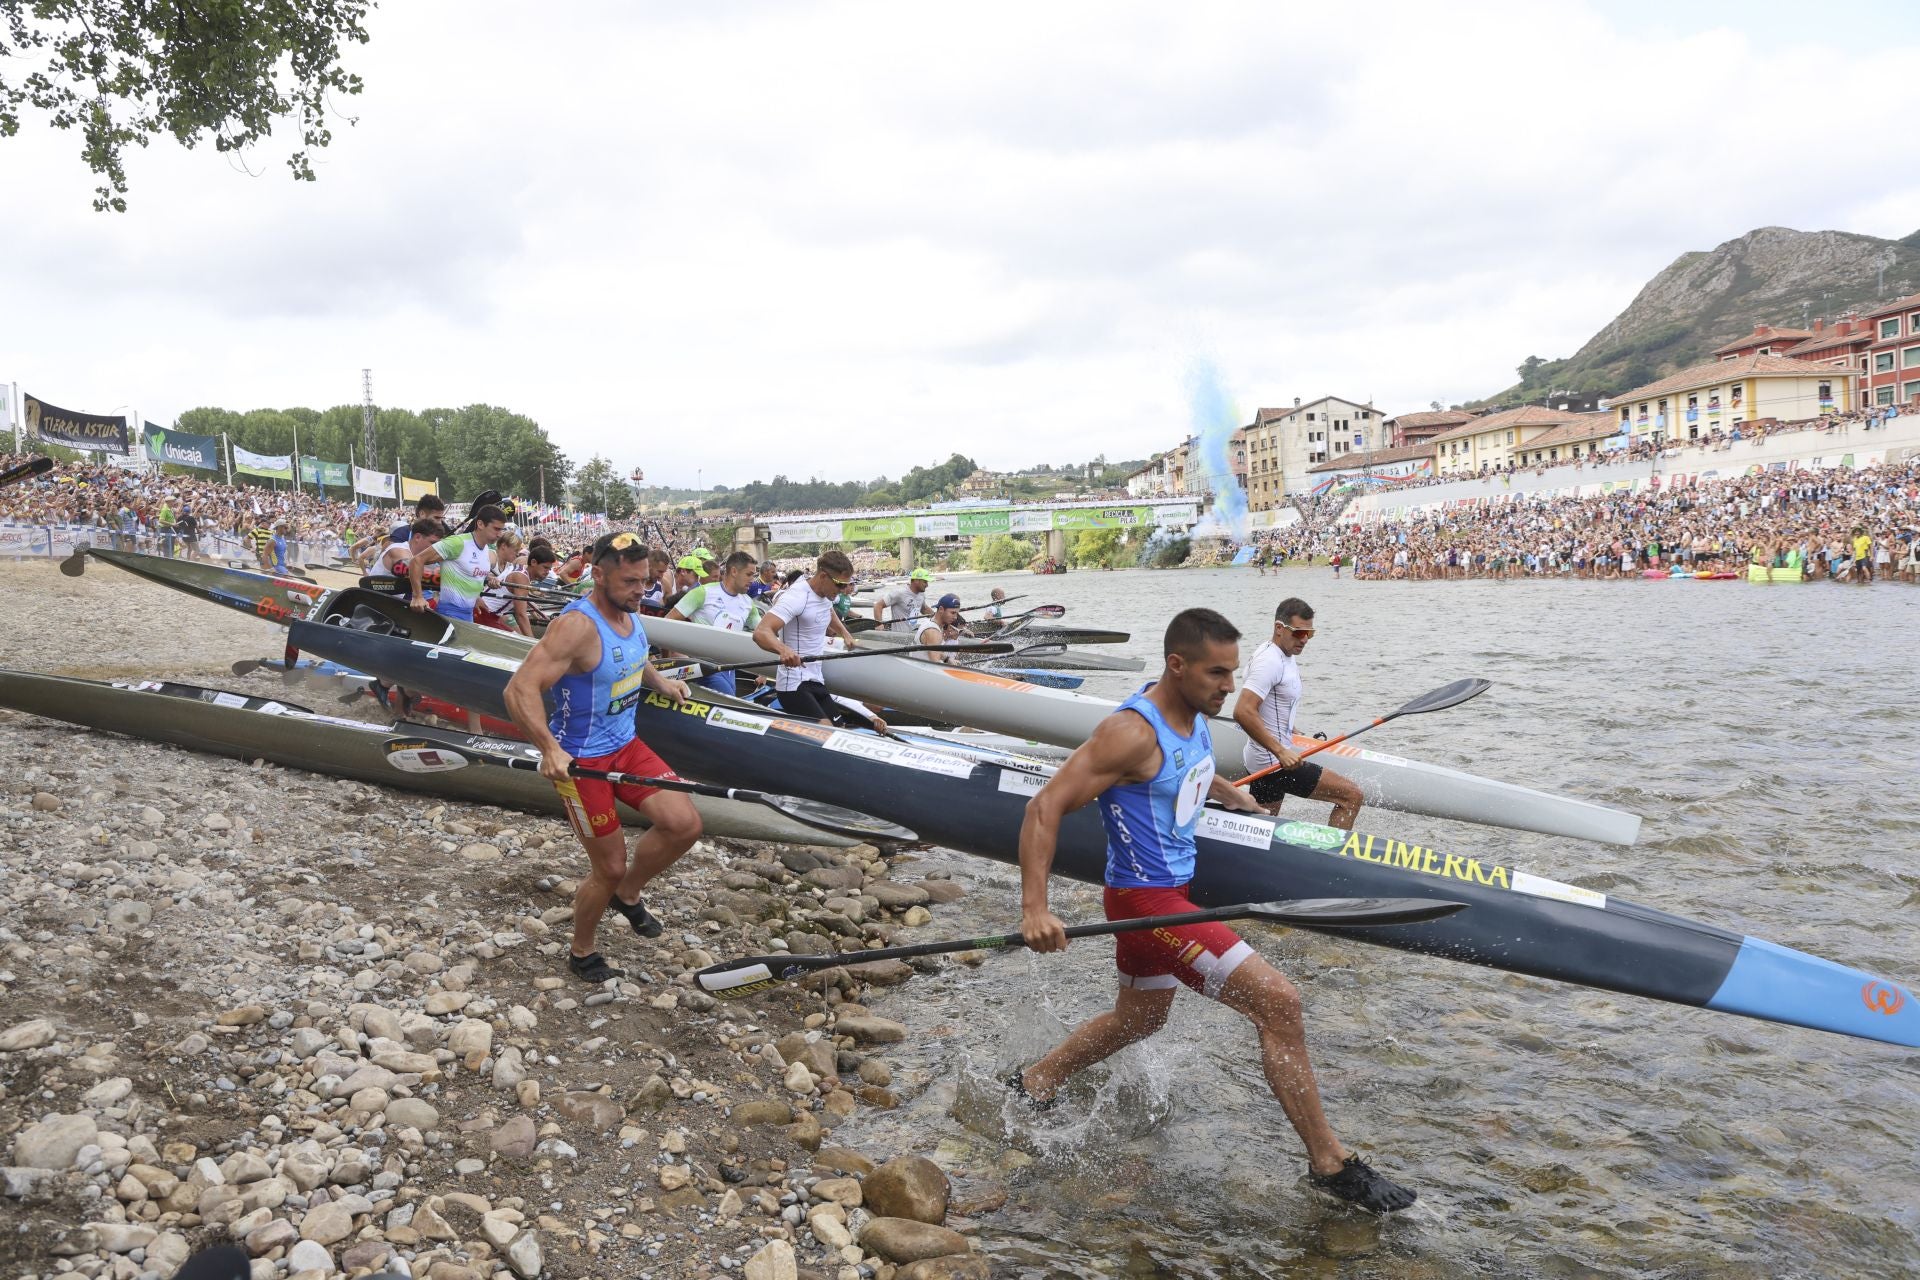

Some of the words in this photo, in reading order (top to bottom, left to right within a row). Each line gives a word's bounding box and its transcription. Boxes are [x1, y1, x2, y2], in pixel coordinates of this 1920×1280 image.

[43, 415, 80, 437] TIERRA
[84, 422, 120, 438] ASTUR
[164, 443, 203, 466] Unicaja
[643, 690, 711, 719] ASTOR
[1193, 782, 1202, 806] 1
[1206, 816, 1219, 828] CJ
[1222, 819, 1272, 838] SOLUTIONS
[1339, 831, 1510, 889] ALIMERKA
[1152, 927, 1182, 949] ESP
